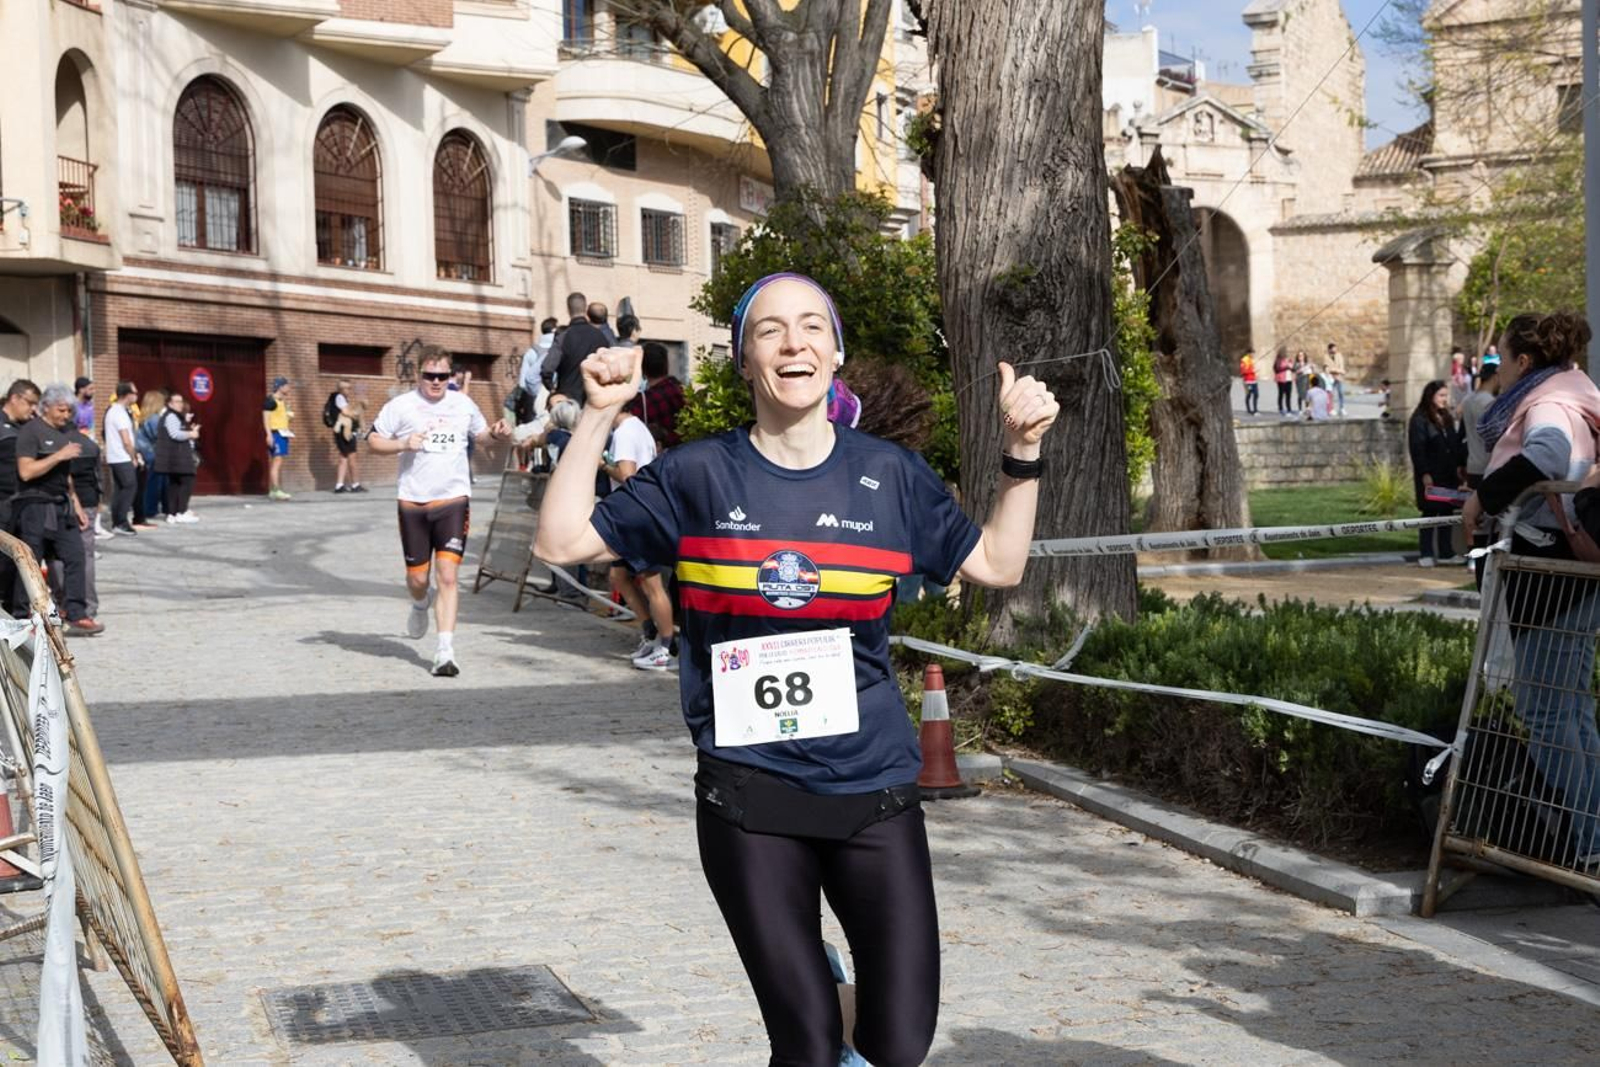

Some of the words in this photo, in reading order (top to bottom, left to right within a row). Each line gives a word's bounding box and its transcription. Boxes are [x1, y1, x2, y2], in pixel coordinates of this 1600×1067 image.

[432, 433, 455, 444] 224
[715, 520, 761, 532] Santander
[841, 519, 873, 532] mupol
[1341, 524, 1379, 535] DEPORTES
[754, 671, 813, 709] 68
[774, 710, 799, 718] NOELIA
[35, 713, 51, 760] DEPORTES
